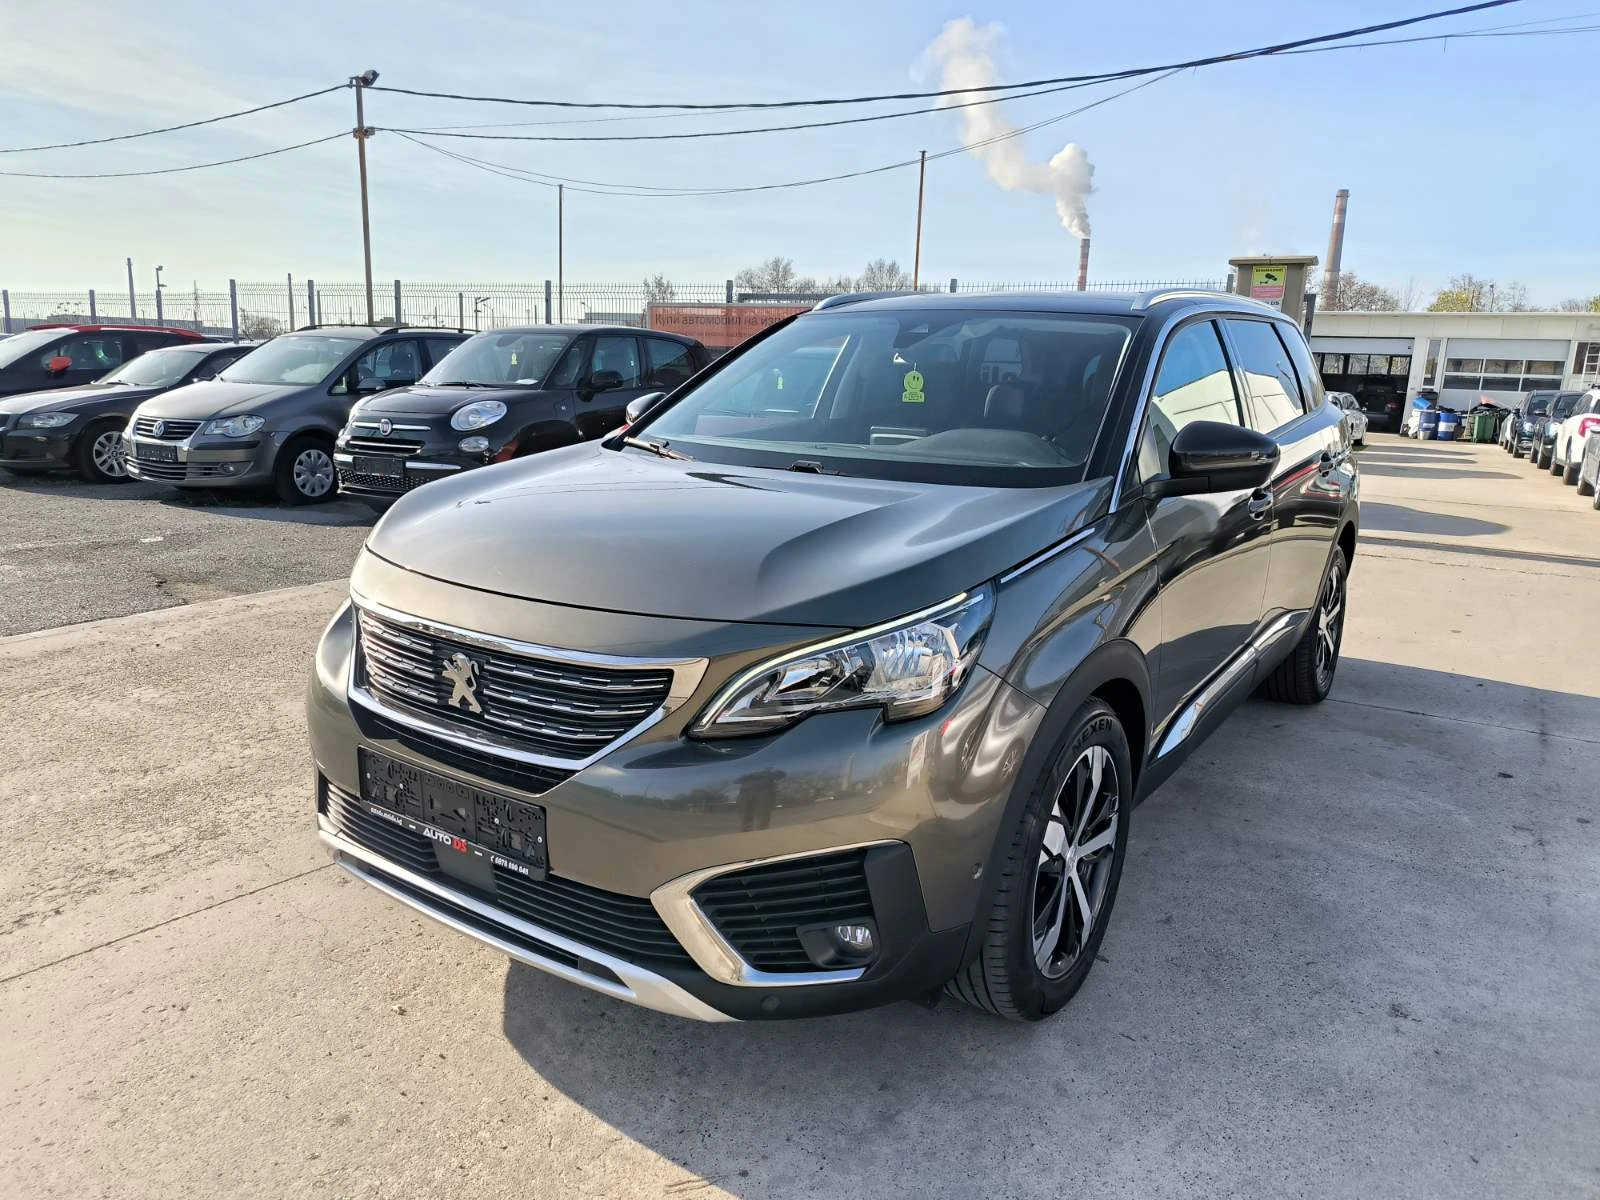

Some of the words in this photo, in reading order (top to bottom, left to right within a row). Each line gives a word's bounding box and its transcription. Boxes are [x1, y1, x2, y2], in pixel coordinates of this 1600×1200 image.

[655, 313, 681, 327] Купи
[682, 313, 741, 326] автомобил
[744, 316, 758, 326] на
[423, 827, 452, 846] AUTO
[452, 837, 468, 853] DS
